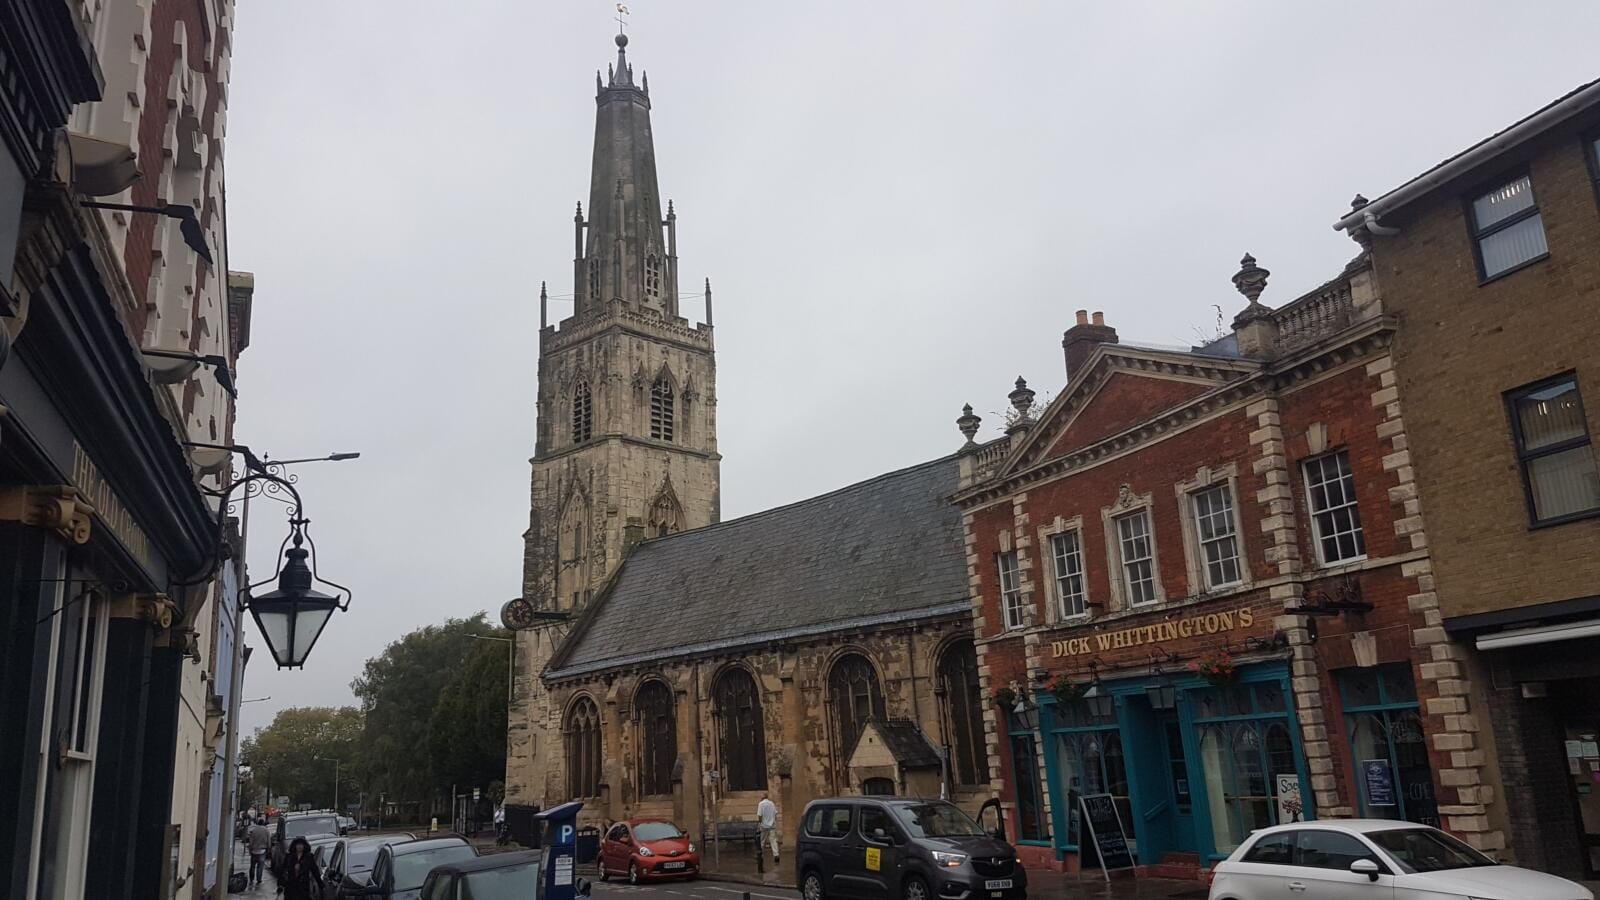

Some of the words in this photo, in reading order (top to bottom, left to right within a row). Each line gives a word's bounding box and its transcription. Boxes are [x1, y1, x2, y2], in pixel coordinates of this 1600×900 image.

[72, 438, 97, 502] THE
[98, 478, 118, 529] OLD
[1051, 636, 1091, 658] DICK
[1095, 606, 1254, 651] WHITTINGTON'S
[561, 824, 573, 843] P
